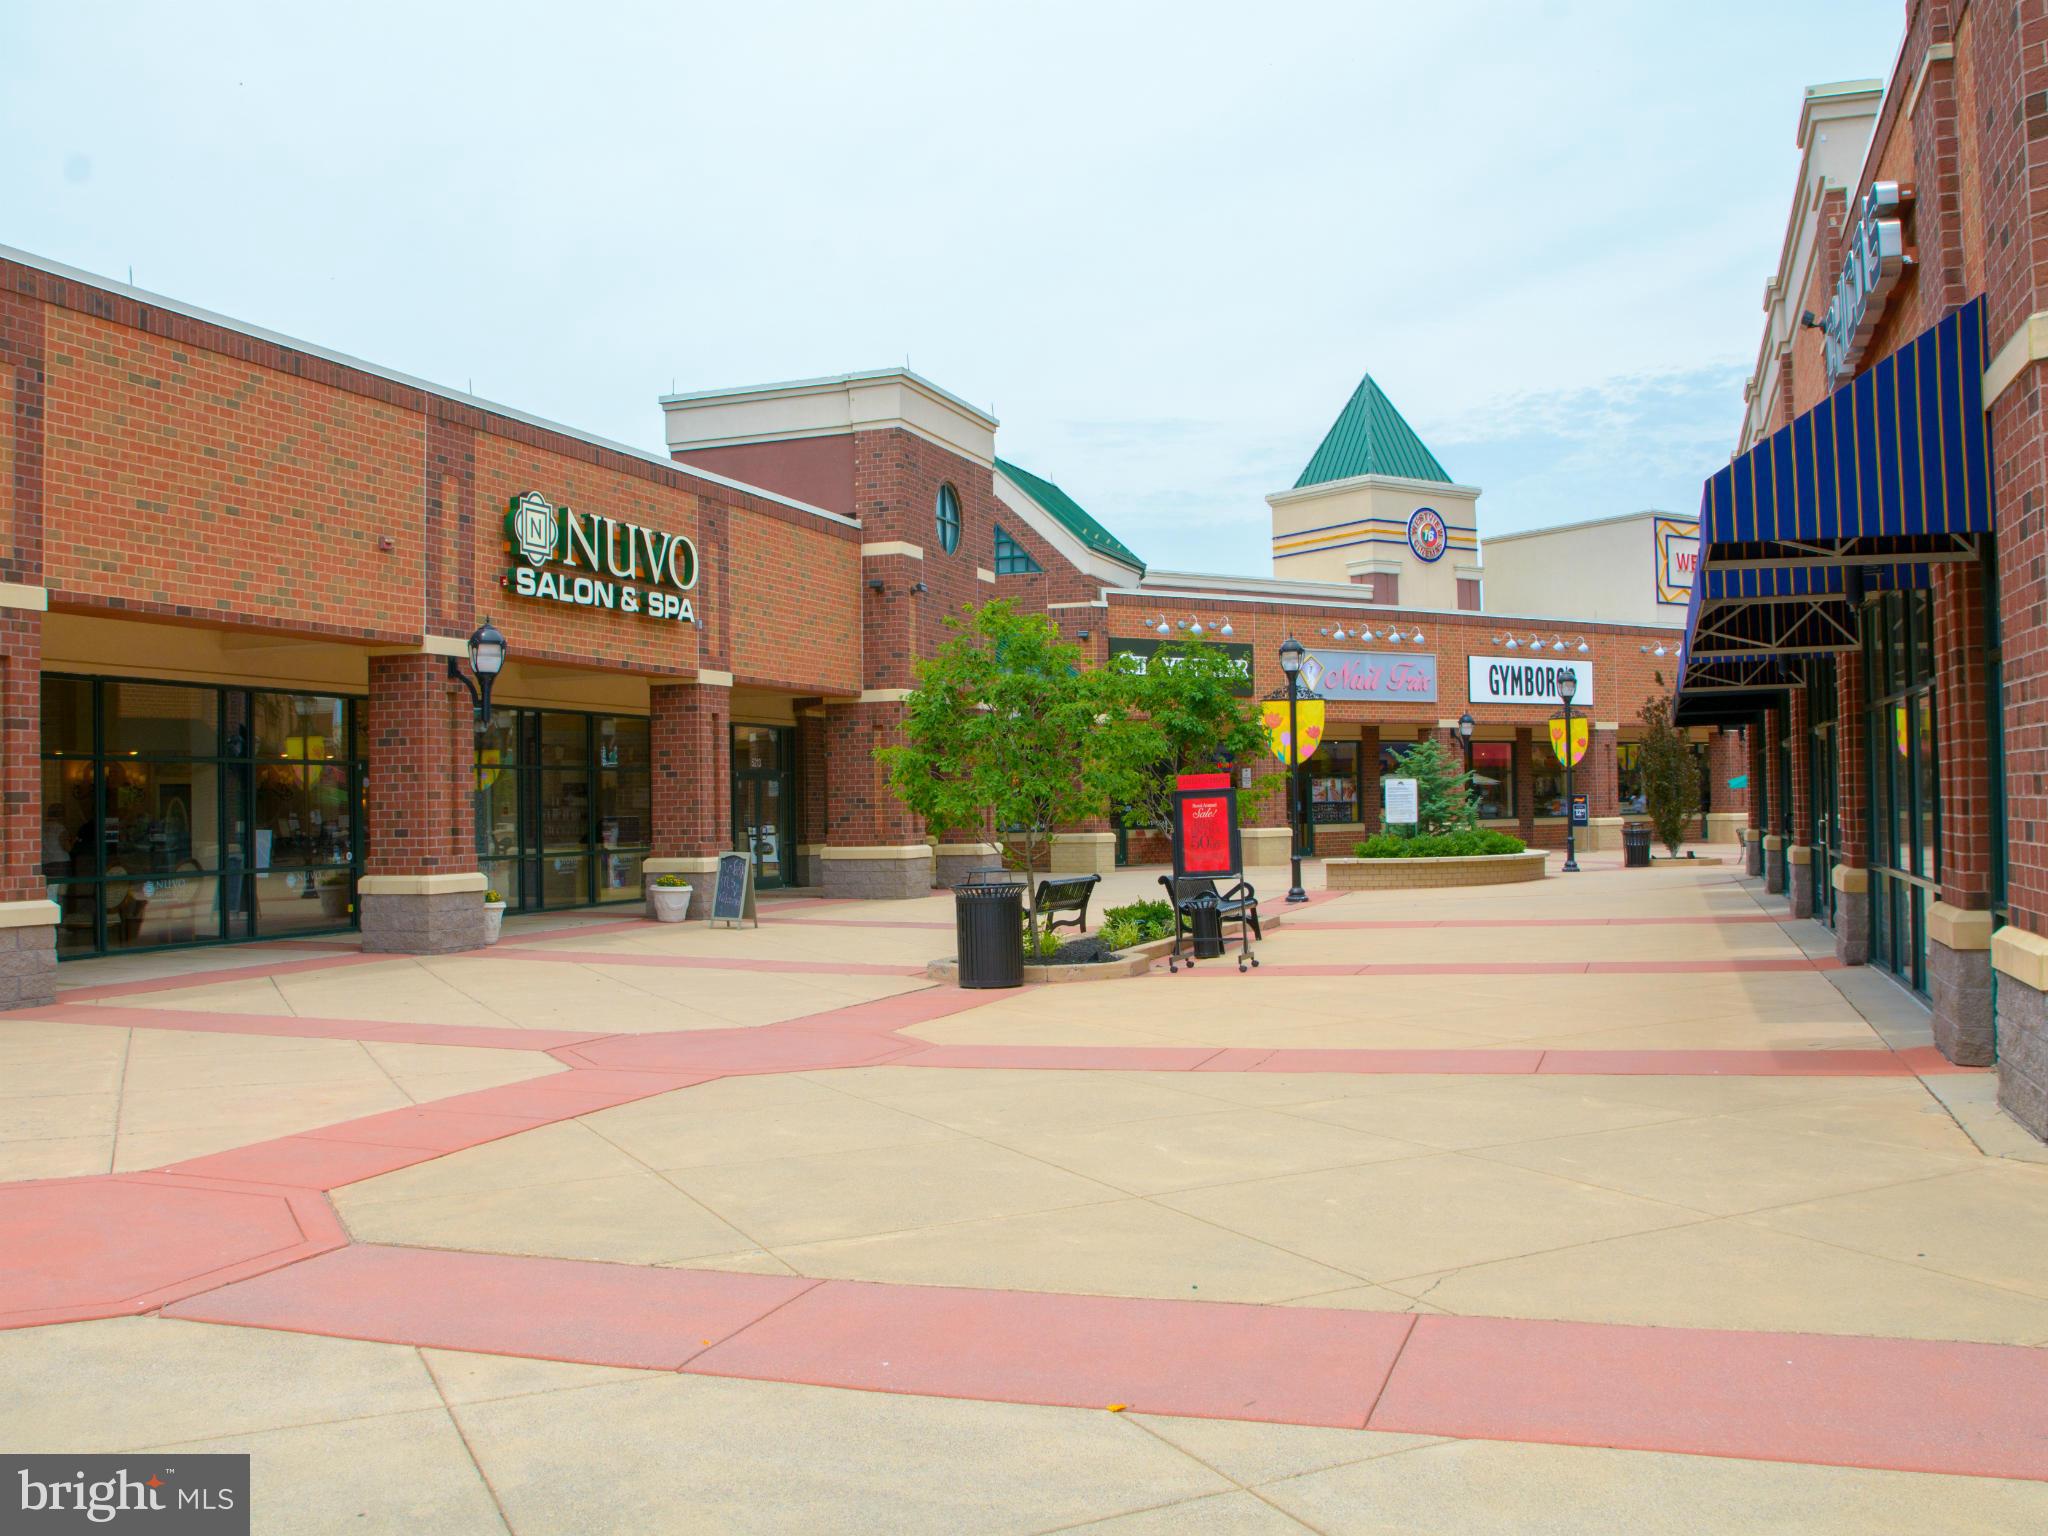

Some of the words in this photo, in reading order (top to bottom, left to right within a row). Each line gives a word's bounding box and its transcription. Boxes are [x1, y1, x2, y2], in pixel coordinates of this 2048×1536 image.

[530, 517, 542, 541] N
[1411, 512, 1443, 537] WESTVIEW
[1423, 529, 1435, 542] 16
[563, 508, 699, 590] NUVO
[516, 566, 614, 608] SALON
[620, 586, 639, 613] &
[648, 591, 696, 623] SPA
[1324, 658, 1384, 691] Nail
[1489, 664, 1576, 697] GYMBOR
[1192, 807, 1218, 819] Sale!
